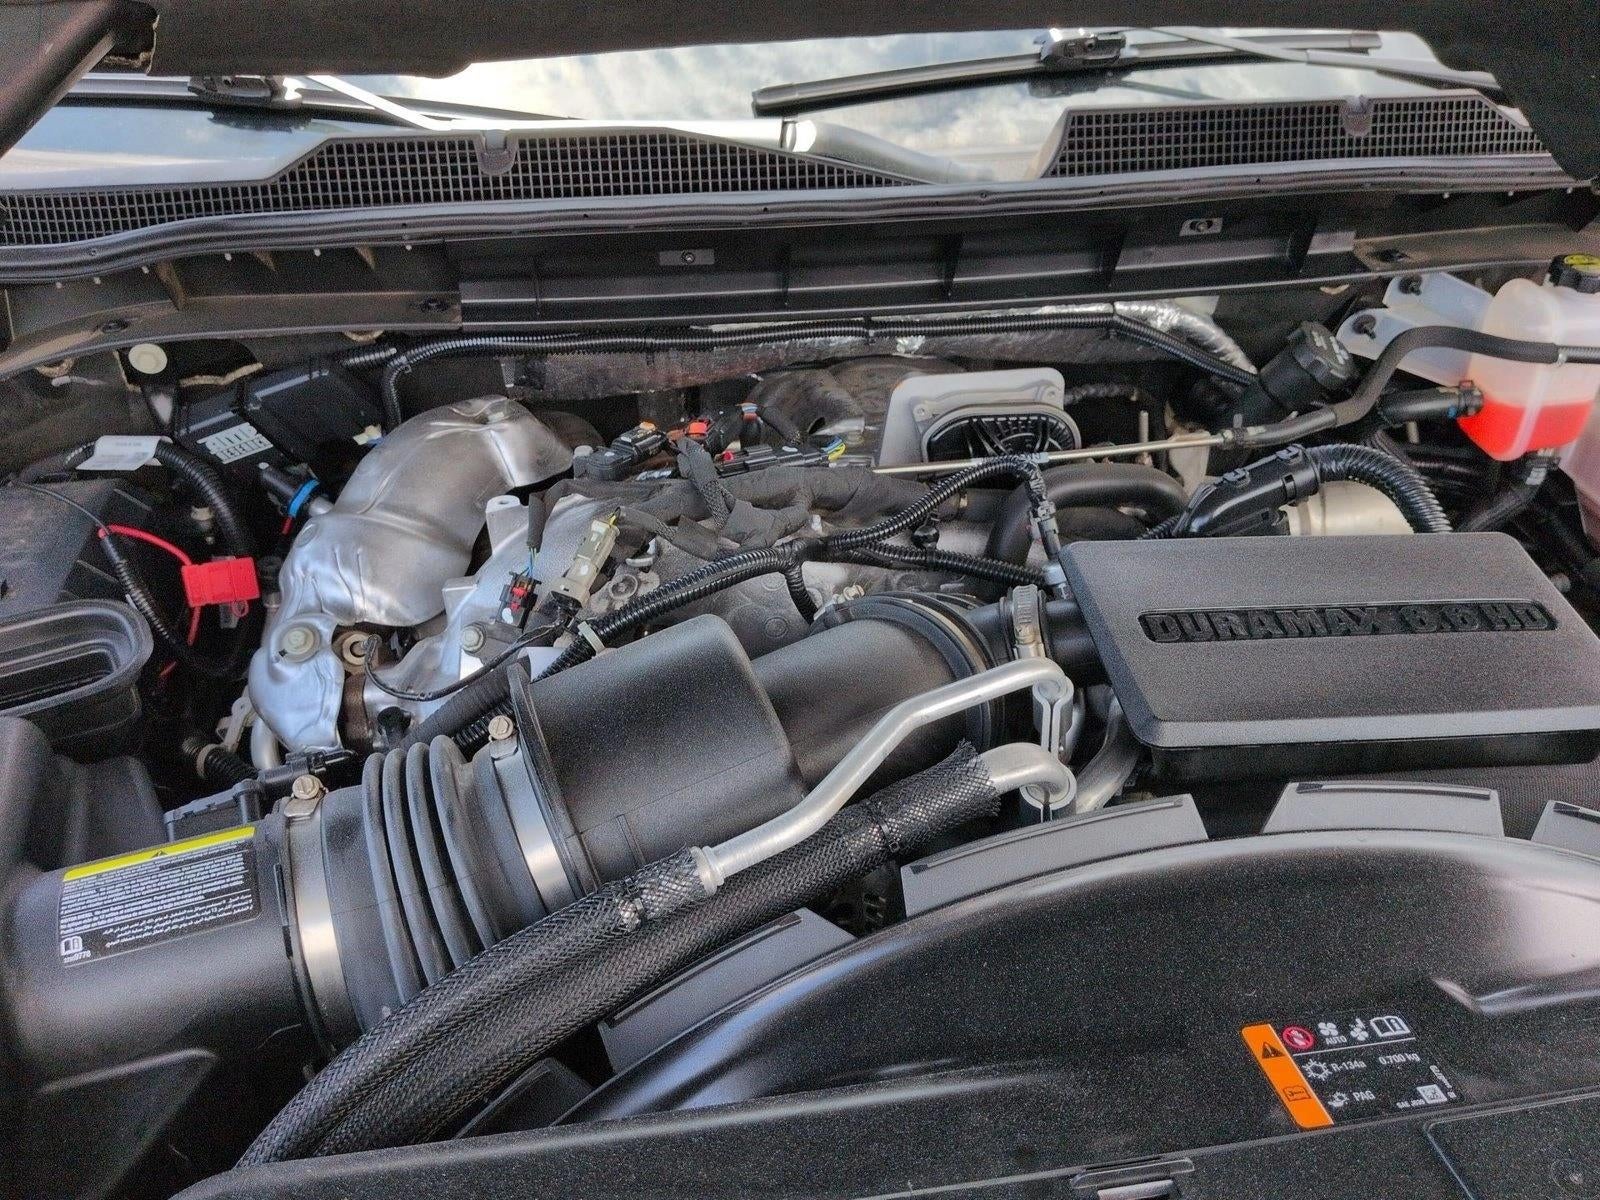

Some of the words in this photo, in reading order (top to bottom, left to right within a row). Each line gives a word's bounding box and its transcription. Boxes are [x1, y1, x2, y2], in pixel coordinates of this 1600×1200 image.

[1142, 606, 1380, 643] DURAMAX
[1400, 603, 1479, 634] 6.6
[1480, 601, 1550, 632] HD
[1325, 1035, 1348, 1046] AUTO
[1331, 1059, 1367, 1073] R-134a
[1378, 1053, 1405, 1066] 0.700
[1405, 1051, 1421, 1063] kg
[1352, 1090, 1376, 1102] PAG
